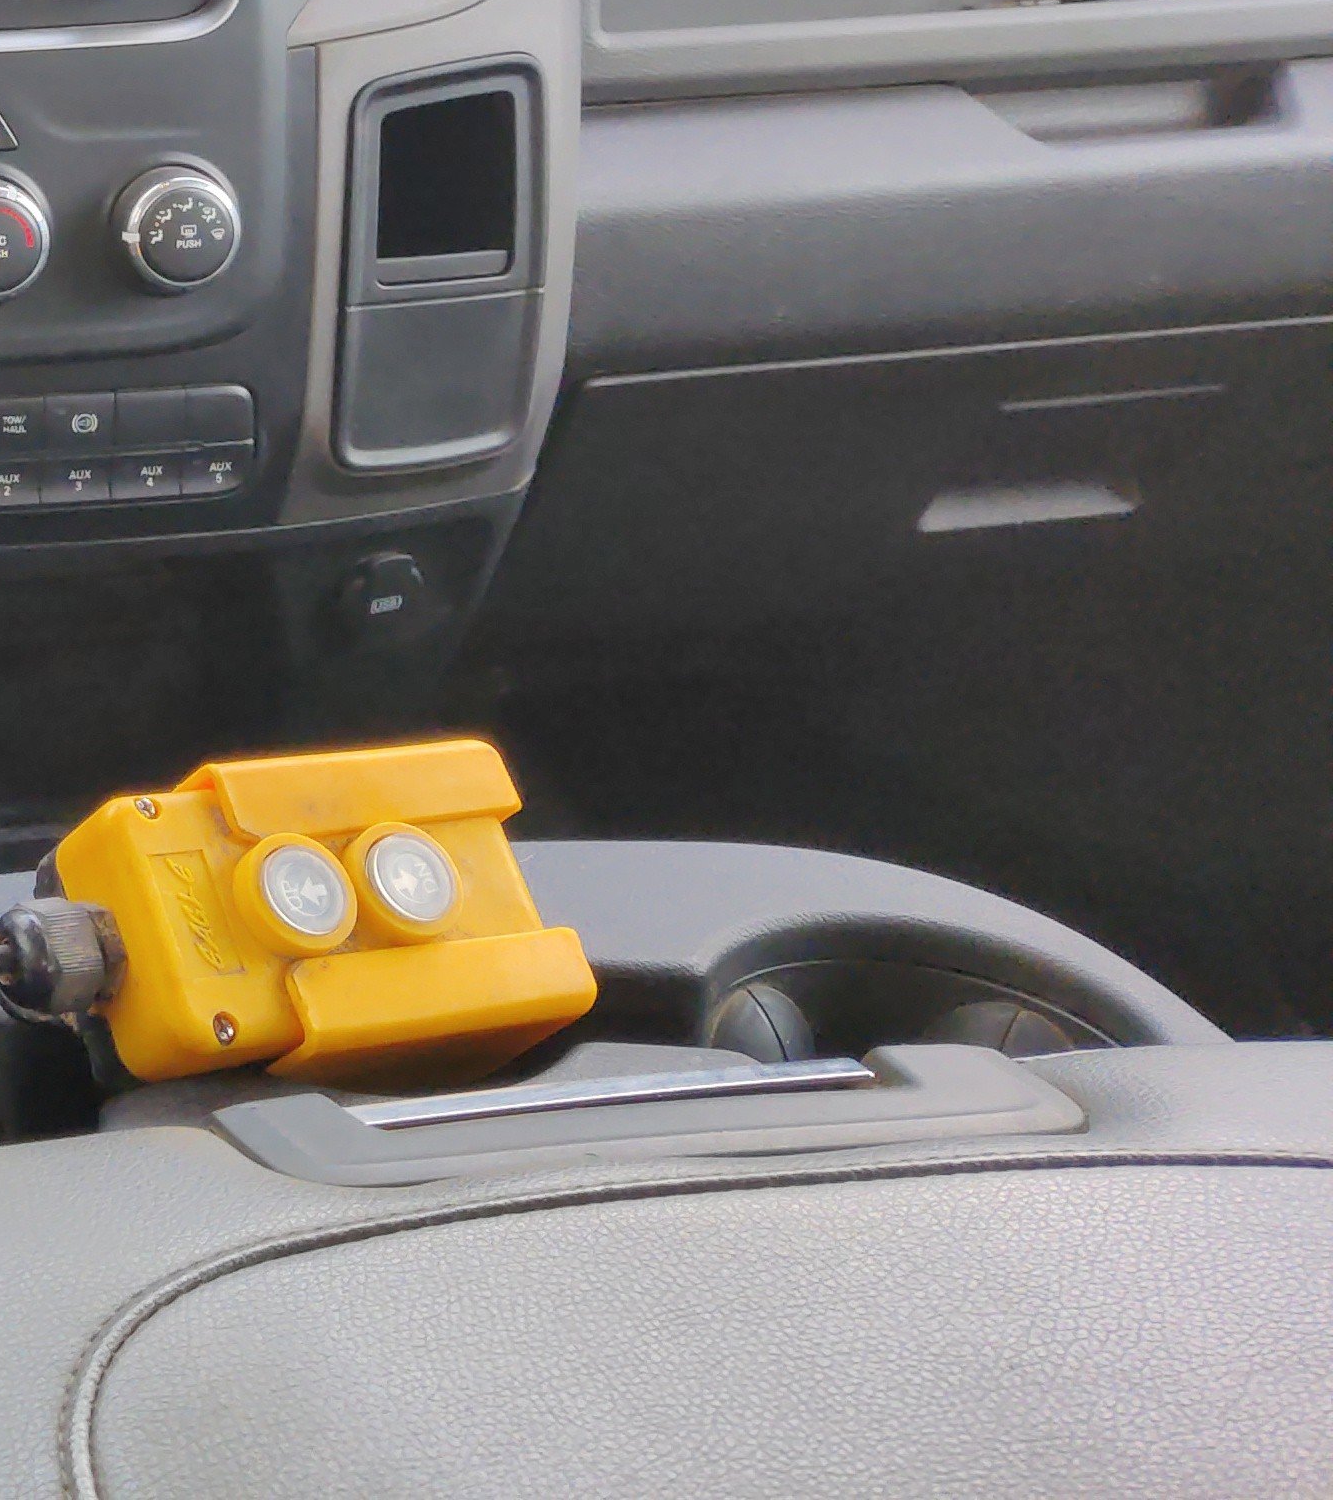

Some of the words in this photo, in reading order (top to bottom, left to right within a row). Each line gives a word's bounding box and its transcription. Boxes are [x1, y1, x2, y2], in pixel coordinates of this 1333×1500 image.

[176, 239, 202, 249] PUSH
[140, 465, 163, 476] AUX
[209, 461, 232, 472] AUX
[68, 469, 92, 480] AUX
